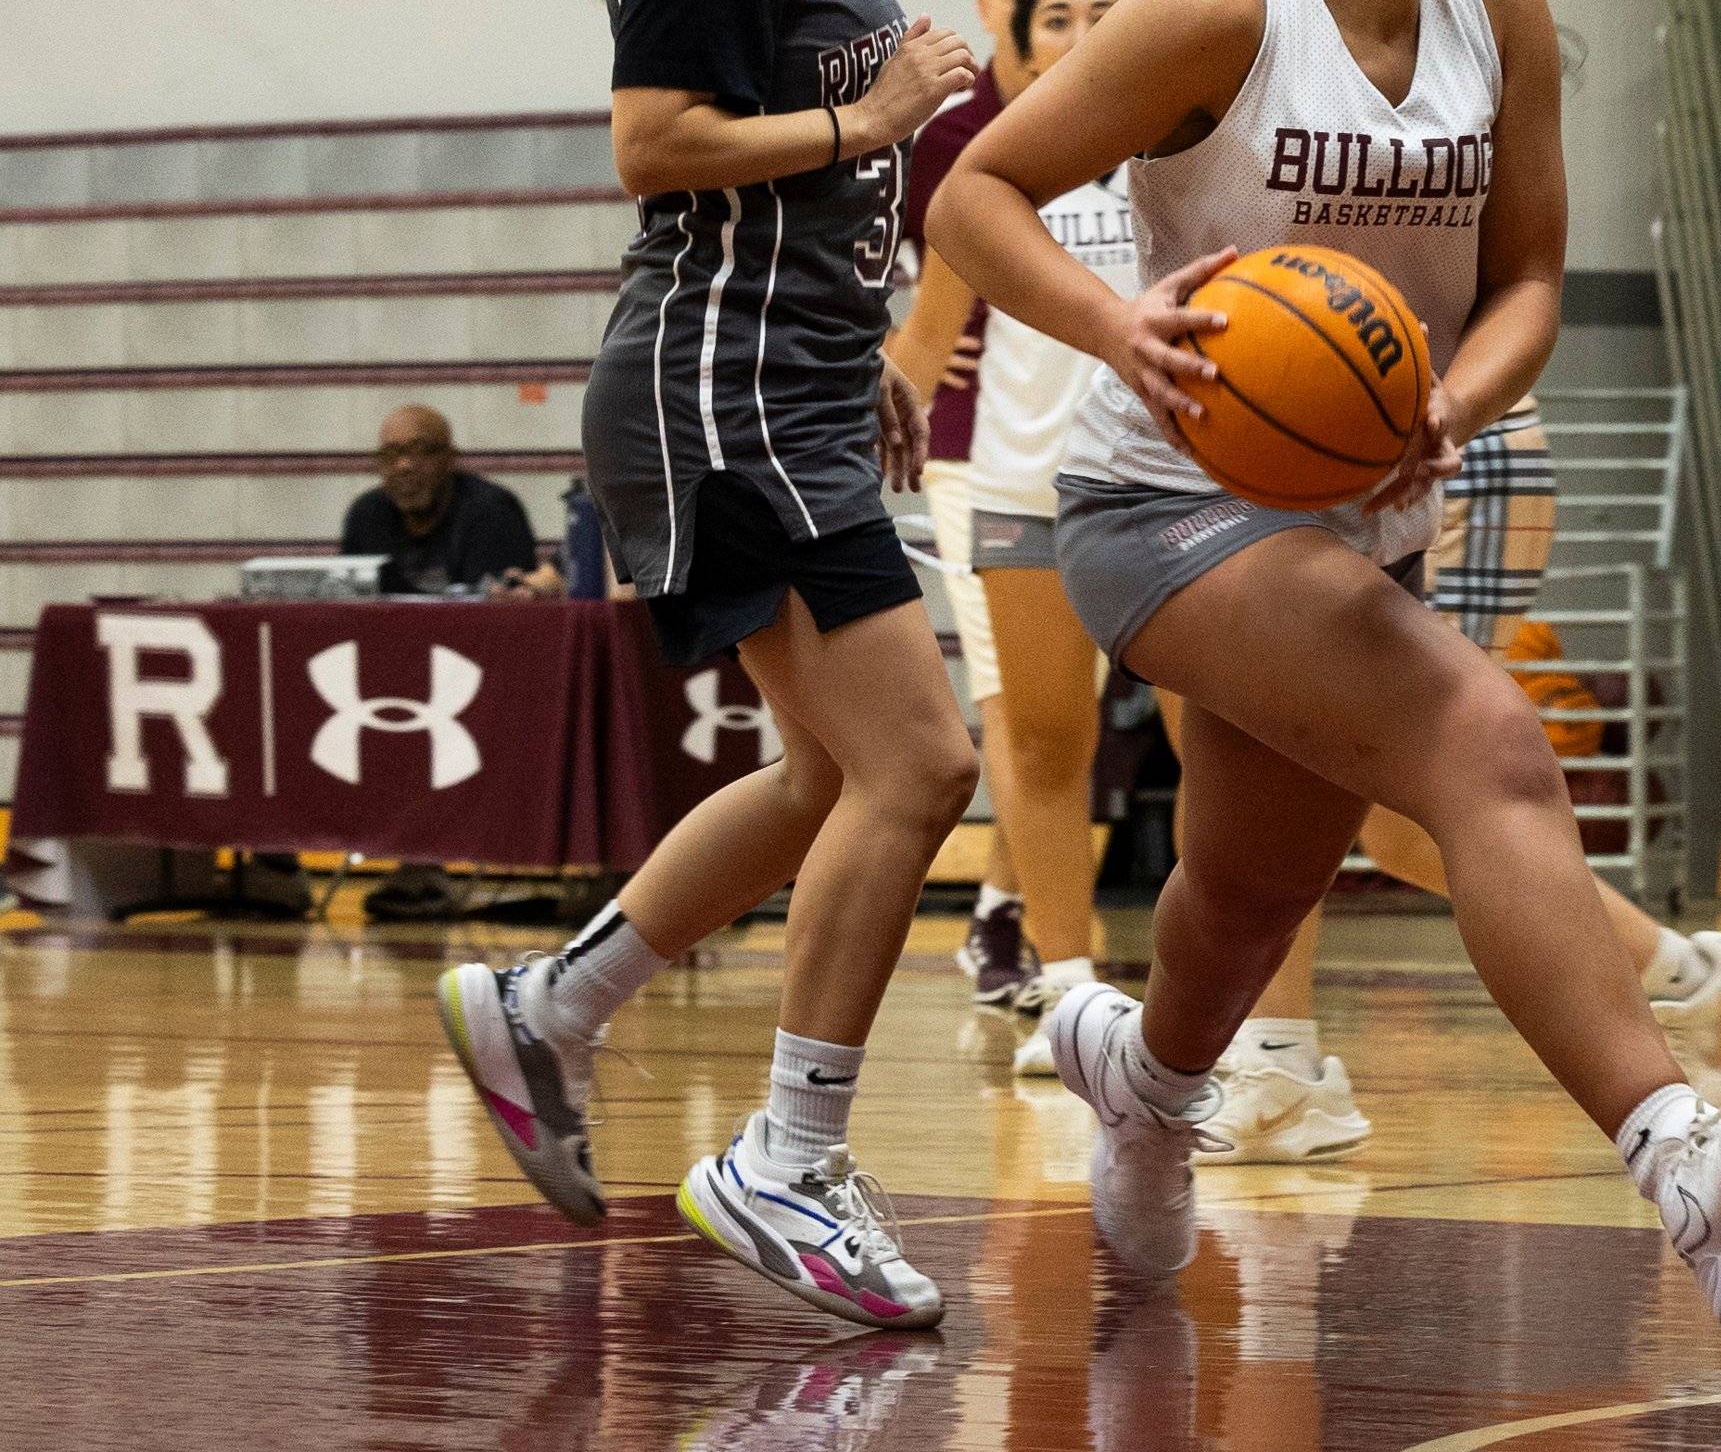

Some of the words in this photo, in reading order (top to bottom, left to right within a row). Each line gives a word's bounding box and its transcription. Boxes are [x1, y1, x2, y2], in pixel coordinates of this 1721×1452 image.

[1292, 200, 1475, 228] BASKETBALL
[1269, 254, 1404, 379] Wilson
[97, 615, 228, 795] R
